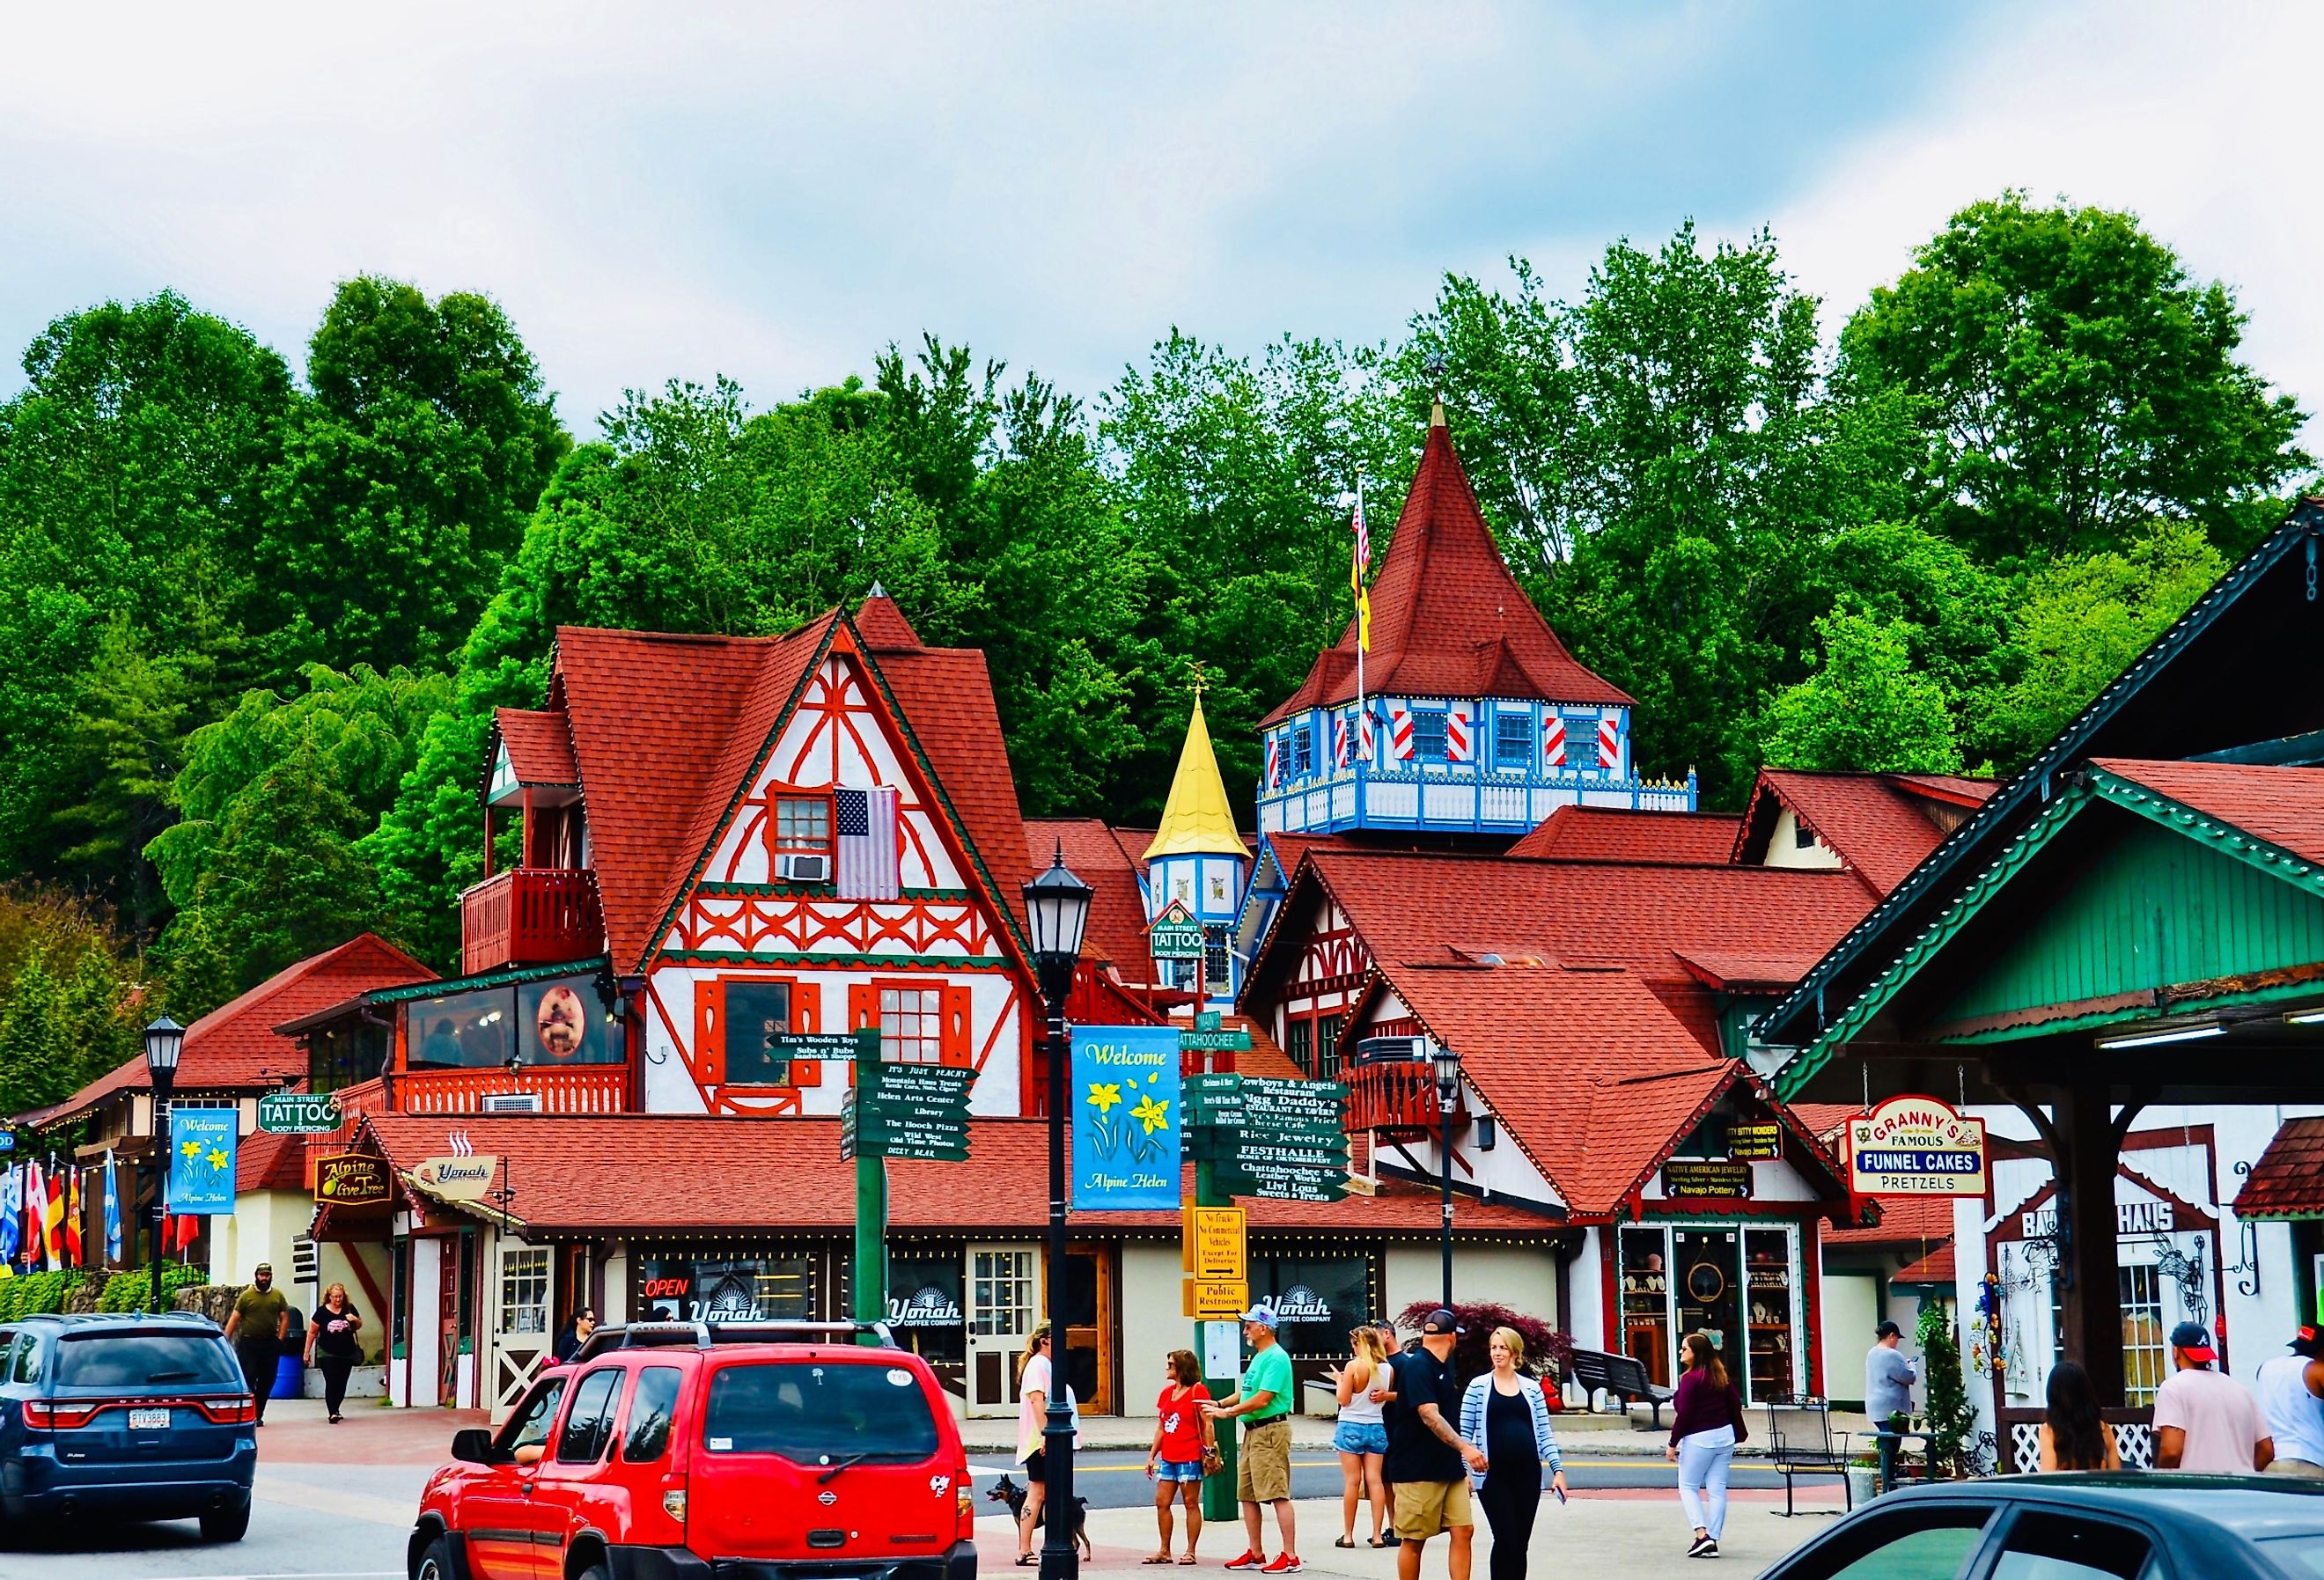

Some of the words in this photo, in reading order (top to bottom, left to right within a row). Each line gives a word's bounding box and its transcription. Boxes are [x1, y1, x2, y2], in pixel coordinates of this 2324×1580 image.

[1151, 933, 1202, 947] TATTOO
[1180, 1033, 1234, 1047] ATTAHOOCHEE
[1085, 1044, 1167, 1066] Welcome
[909, 1067, 929, 1076] JUST
[936, 1069, 967, 1079] PEACHY
[940, 1079, 961, 1088] Treats
[1301, 1081, 1336, 1091] Angels
[1262, 1088, 1315, 1097] Restaurant
[926, 1095, 954, 1104] Center
[1278, 1097, 1338, 1108] Daddy's
[915, 1107, 944, 1118] Library
[1240, 1104, 1292, 1113] ESTAURANT
[1305, 1107, 1335, 1116] TAVERN
[180, 1119, 229, 1132] Welcome
[905, 1121, 932, 1130] Hooch
[937, 1123, 959, 1132] Pizza
[1873, 1111, 1959, 1141] GRANNY'S
[1276, 1133, 1335, 1146] Jewelry
[1892, 1136, 1944, 1146] FAMOUS
[914, 1148, 935, 1157] BEAR
[1240, 1146, 1325, 1157] FESTHALLE
[1734, 1148, 1752, 1157] Navajo
[1864, 1154, 1921, 1171] FUNNEL
[1926, 1154, 1974, 1171] CAKES
[325, 1160, 375, 1179] Alpine
[438, 1164, 489, 1183] Yonah
[1241, 1163, 1320, 1176] Chattahoochee
[1324, 1169, 1337, 1178] St.
[1085, 1173, 1129, 1192] Alpine
[1130, 1173, 1167, 1188] Helen
[1294, 1174, 1321, 1183] Works
[1881, 1176, 1955, 1189] PRETZELS
[356, 1176, 384, 1195] Tree
[1266, 1181, 1287, 1190] Livi
[1291, 1183, 1318, 1193] Lous
[1680, 1186, 1707, 1195] Navajo
[1709, 1186, 1736, 1195] Pottery
[1256, 1188, 1289, 1199] Sweets
[1298, 1192, 1329, 1202] Treats
[2116, 1202, 2173, 1232] HAUS
[1208, 1225, 1239, 1234] Commercial
[1209, 1237, 1231, 1246] Vehicles
[645, 1279, 689, 1297] OPEN
[1206, 1287, 1236, 1296] Public
[688, 1301, 767, 1322] Yonah
[1262, 1295, 1331, 1316] Yonah
[886, 1298, 962, 1327] Yonah
